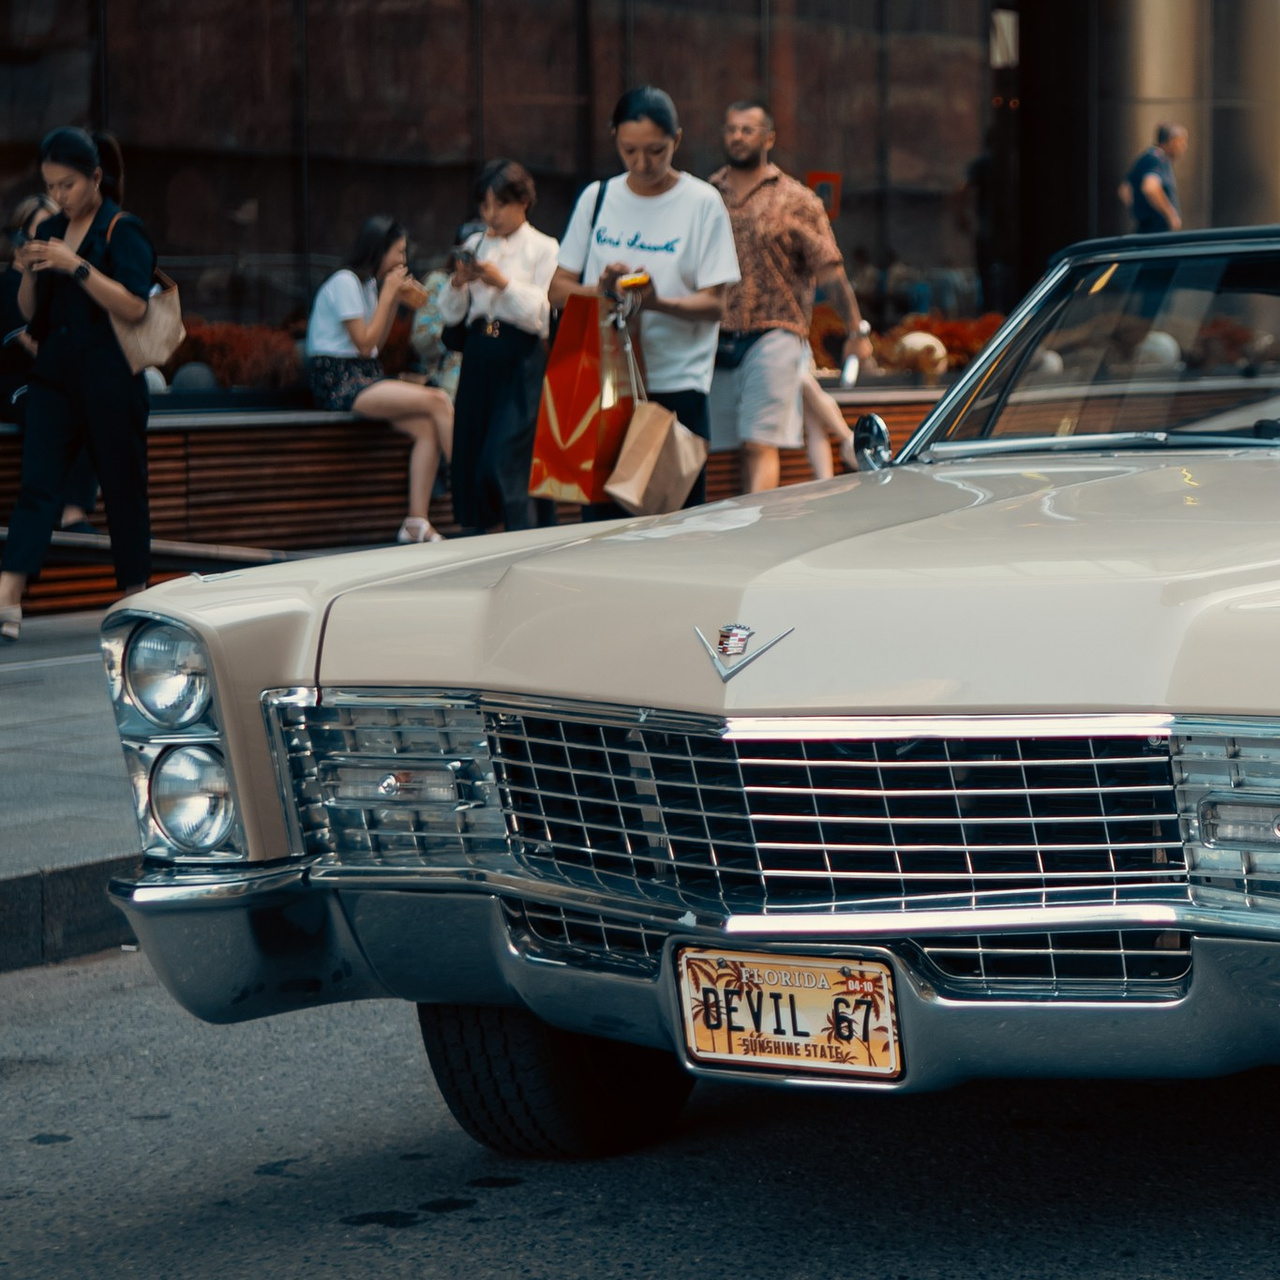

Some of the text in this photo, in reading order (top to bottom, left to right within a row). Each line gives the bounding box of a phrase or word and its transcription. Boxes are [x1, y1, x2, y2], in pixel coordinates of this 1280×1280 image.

[741, 967, 831, 990] FLORIDA
[848, 979, 874, 992] 04-10
[701, 986, 873, 1042] DEVIL 67
[742, 1037, 844, 1060] SUNSHINE STATE
